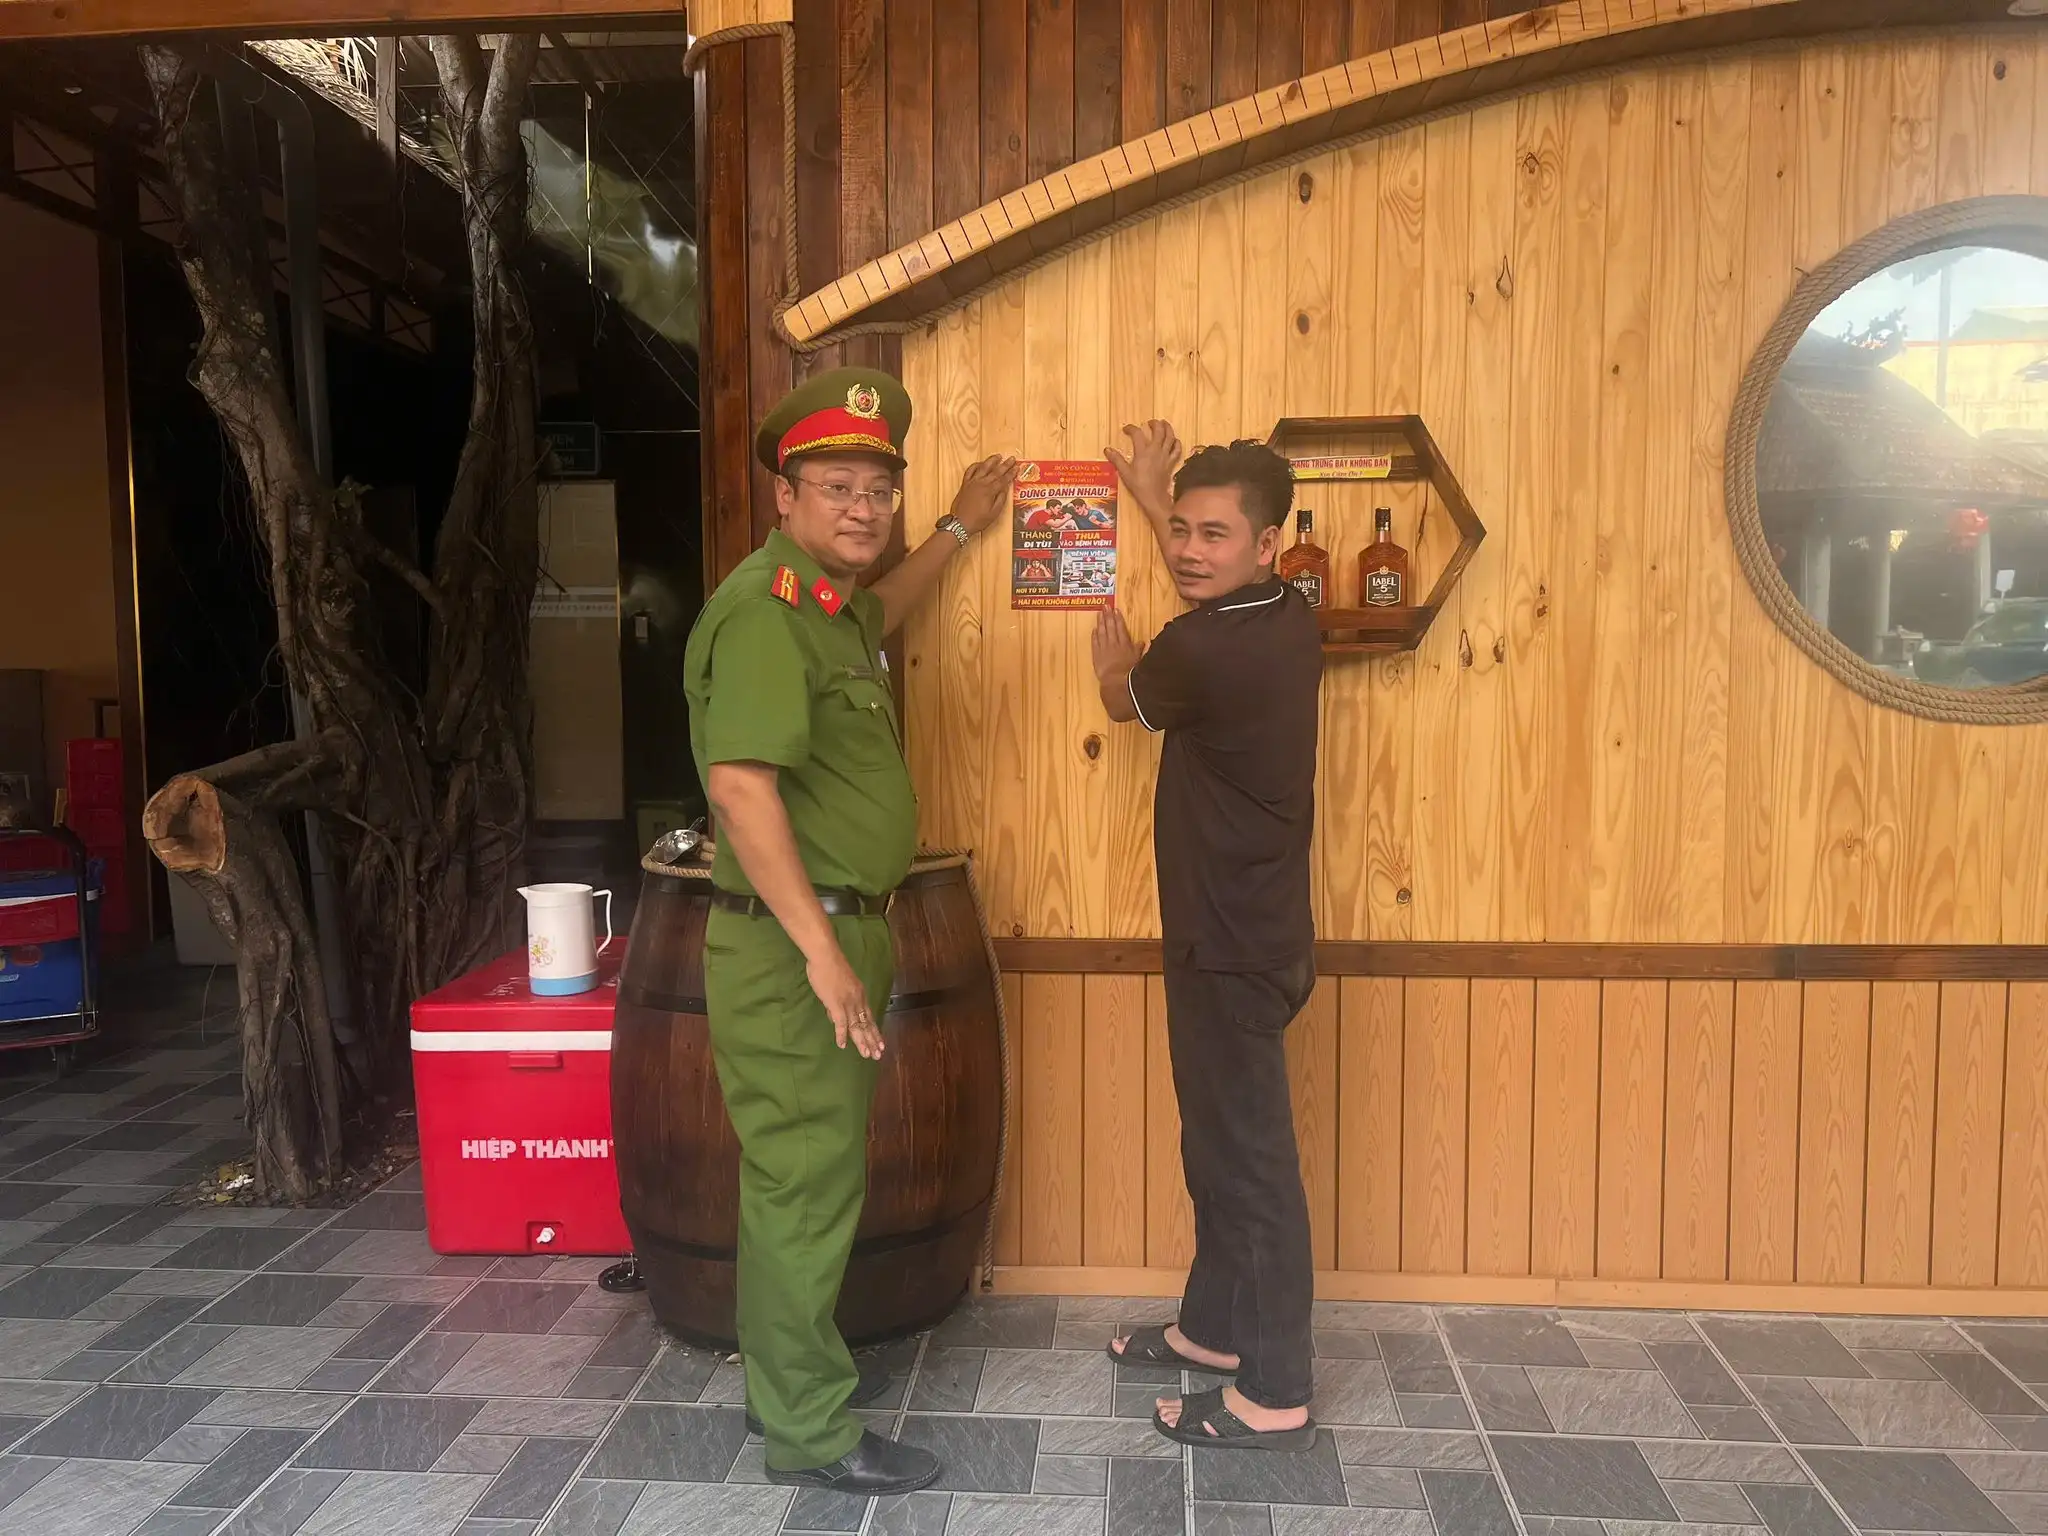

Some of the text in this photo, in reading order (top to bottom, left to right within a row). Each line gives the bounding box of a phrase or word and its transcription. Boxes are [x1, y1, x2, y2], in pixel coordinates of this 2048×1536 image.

[1077, 487, 1108, 497] NHAU!
[1075, 532, 1100, 540] THUA
[1294, 580, 1318, 589] LABEL
[1373, 577, 1397, 586] LABEL
[1380, 584, 1388, 592] 5
[461, 1137, 517, 1161] HIỆP
